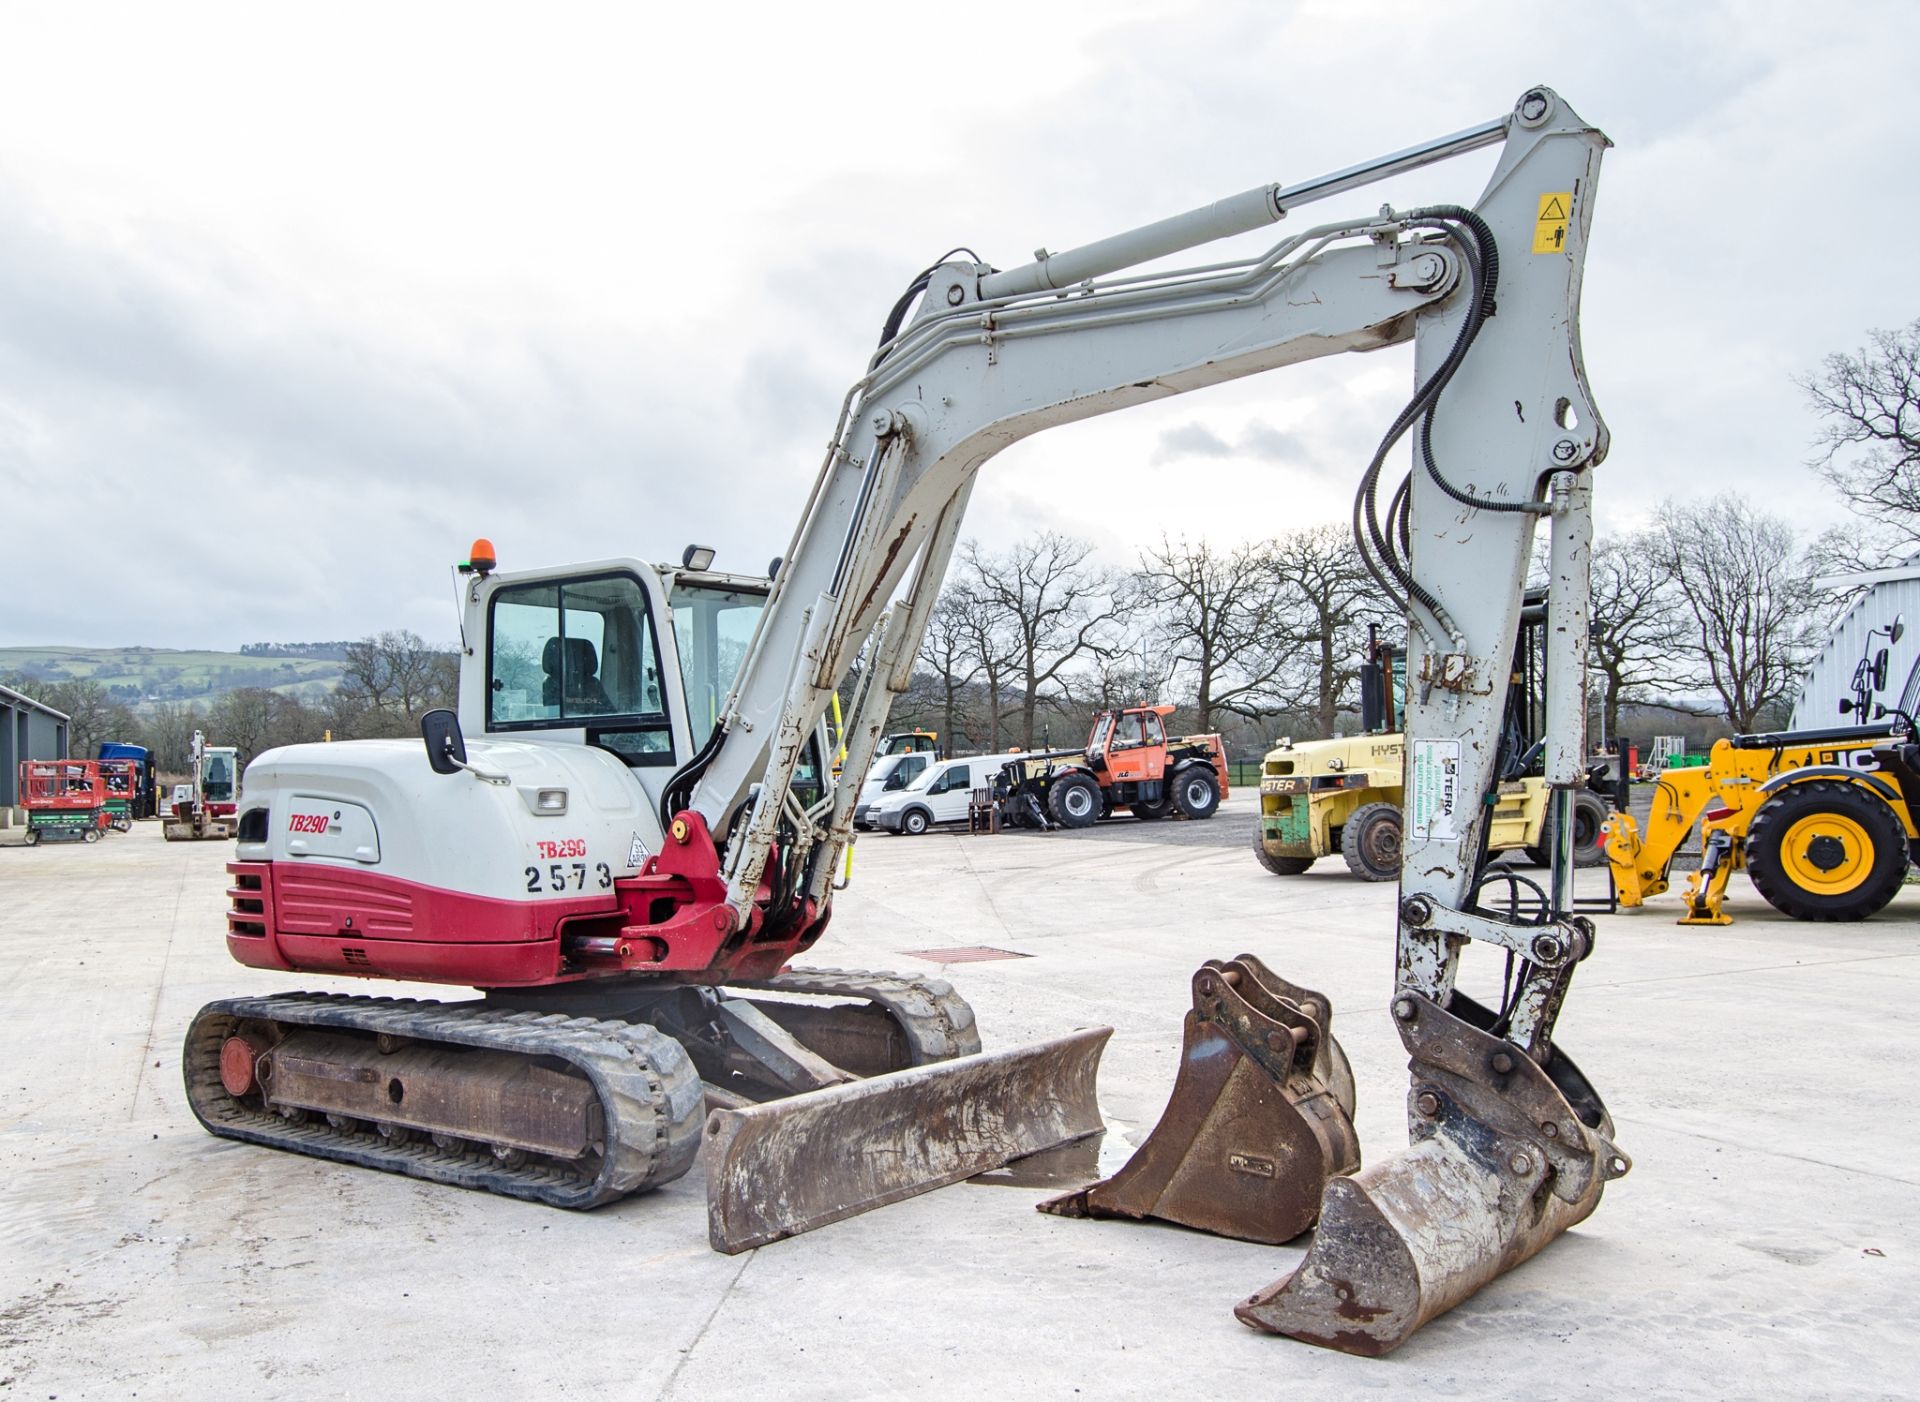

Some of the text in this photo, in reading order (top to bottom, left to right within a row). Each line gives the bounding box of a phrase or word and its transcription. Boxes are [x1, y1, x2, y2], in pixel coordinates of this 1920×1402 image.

[1444, 777, 1453, 816] TEFRA
[289, 814, 329, 834] TB290
[537, 839, 586, 859] TB290
[525, 862, 612, 893] 2573
